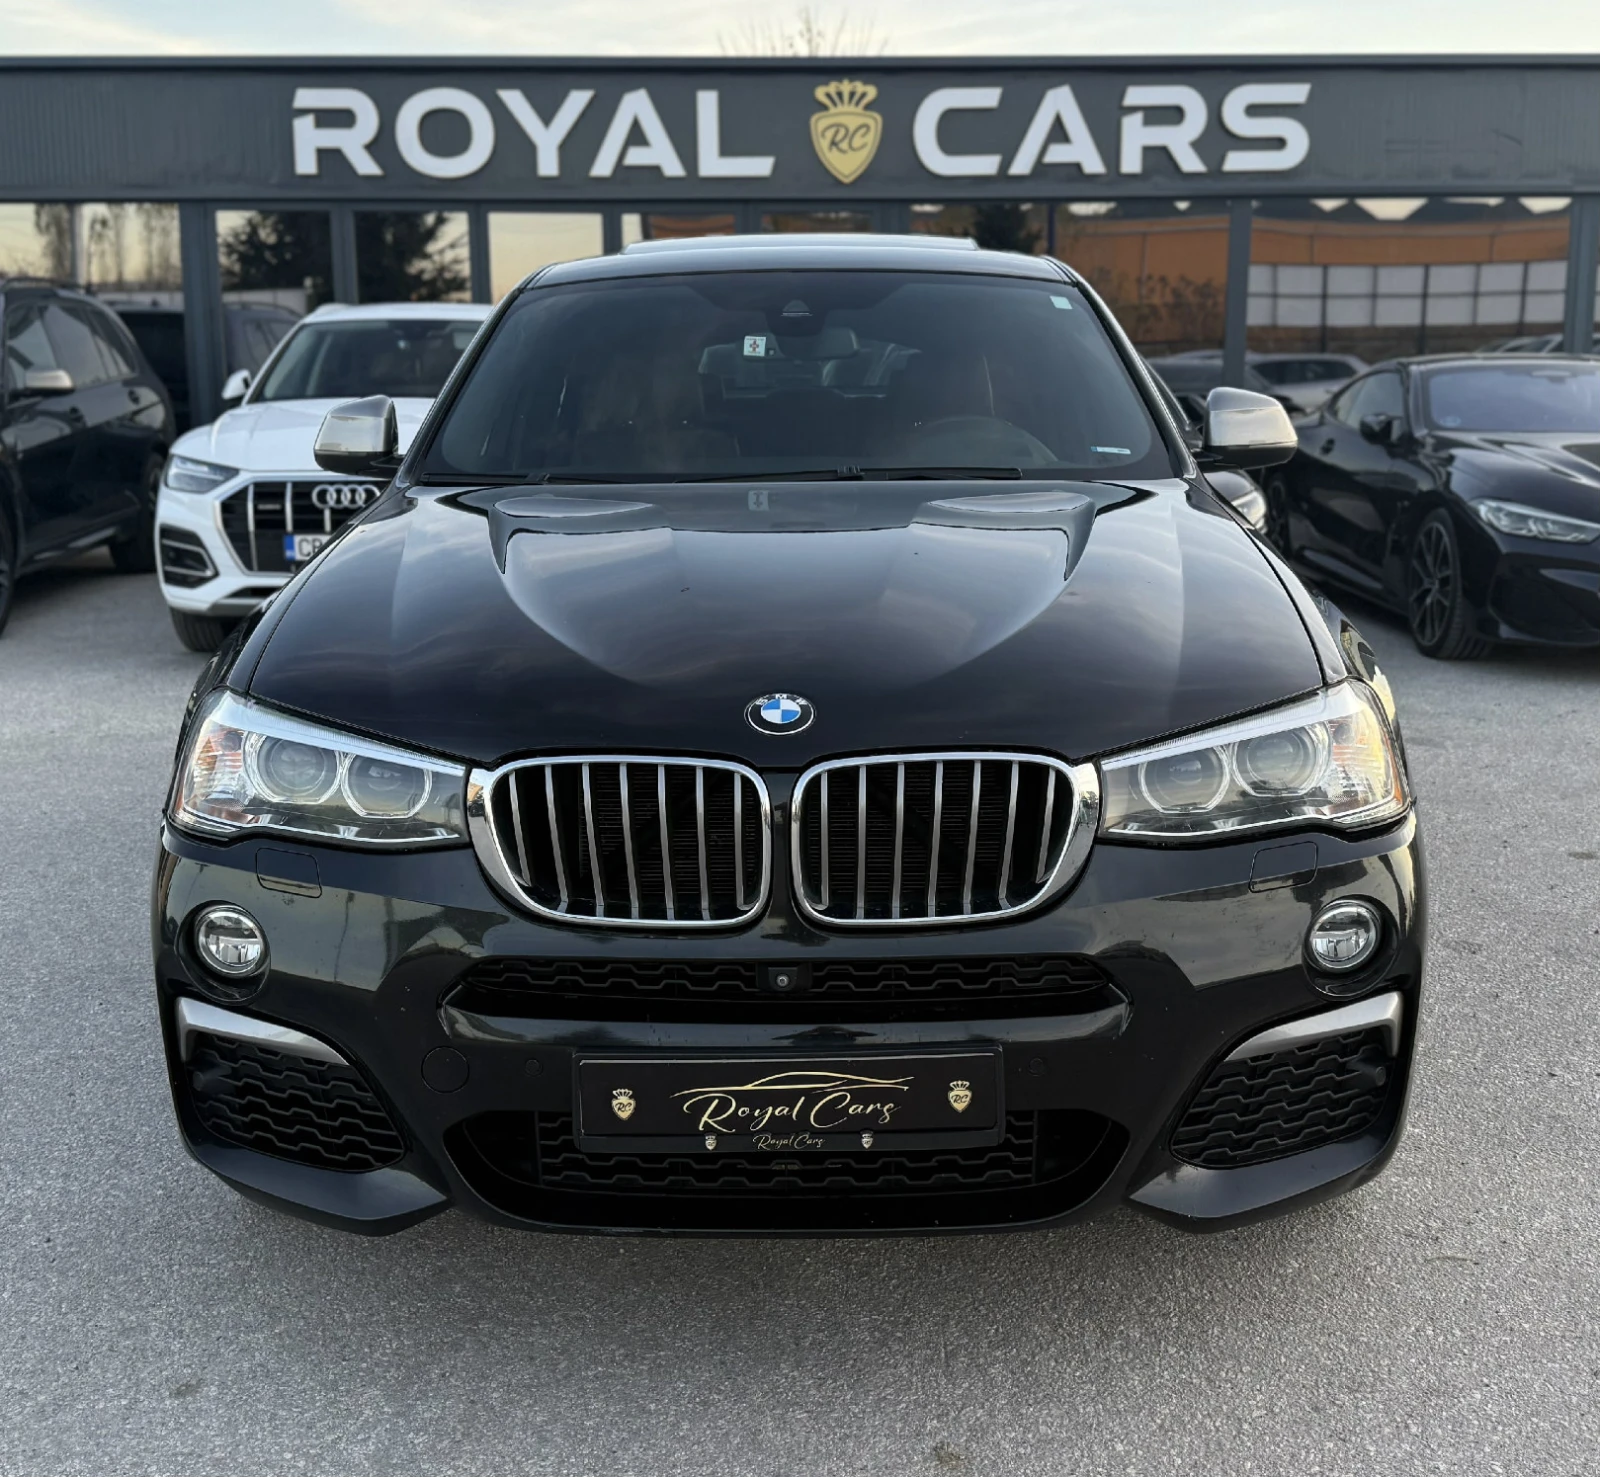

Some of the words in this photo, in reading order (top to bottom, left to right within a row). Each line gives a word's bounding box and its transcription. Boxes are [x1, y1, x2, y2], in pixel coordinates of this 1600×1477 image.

[292, 86, 776, 178] ROYAL
[912, 83, 1312, 177] CARS
[821, 122, 871, 154] RC
[614, 1101, 633, 1113] RC
[682, 1092, 806, 1133] Royal
[809, 1091, 902, 1129] Cars
[950, 1094, 969, 1105] RC
[752, 1133, 795, 1151] Royal
[793, 1132, 826, 1150] Cars
